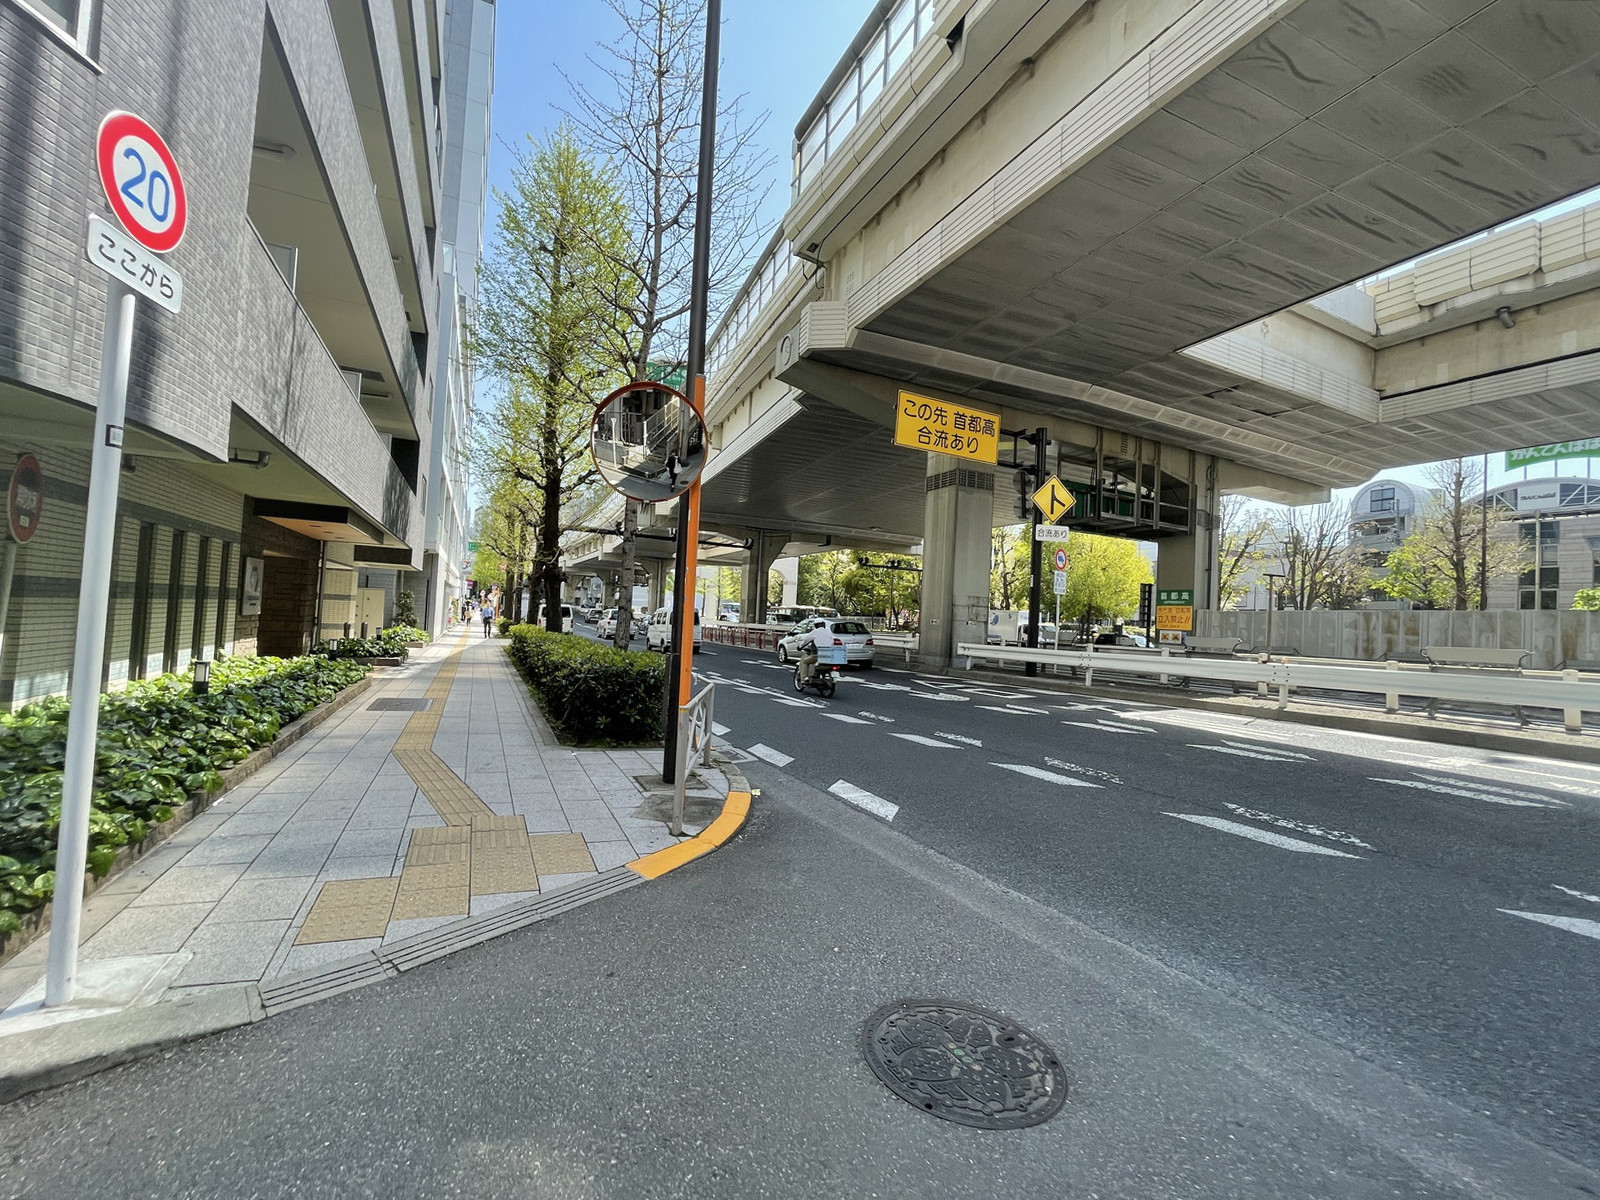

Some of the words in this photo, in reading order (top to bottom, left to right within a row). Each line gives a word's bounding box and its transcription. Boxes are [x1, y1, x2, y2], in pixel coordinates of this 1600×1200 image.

[120, 147, 170, 223] 20
[98, 233, 174, 300] ここから
[903, 399, 948, 426] この先
[953, 410, 996, 438] 首都高
[917, 425, 979, 454] 合流あり
[1038, 528, 1067, 538] 合流あり
